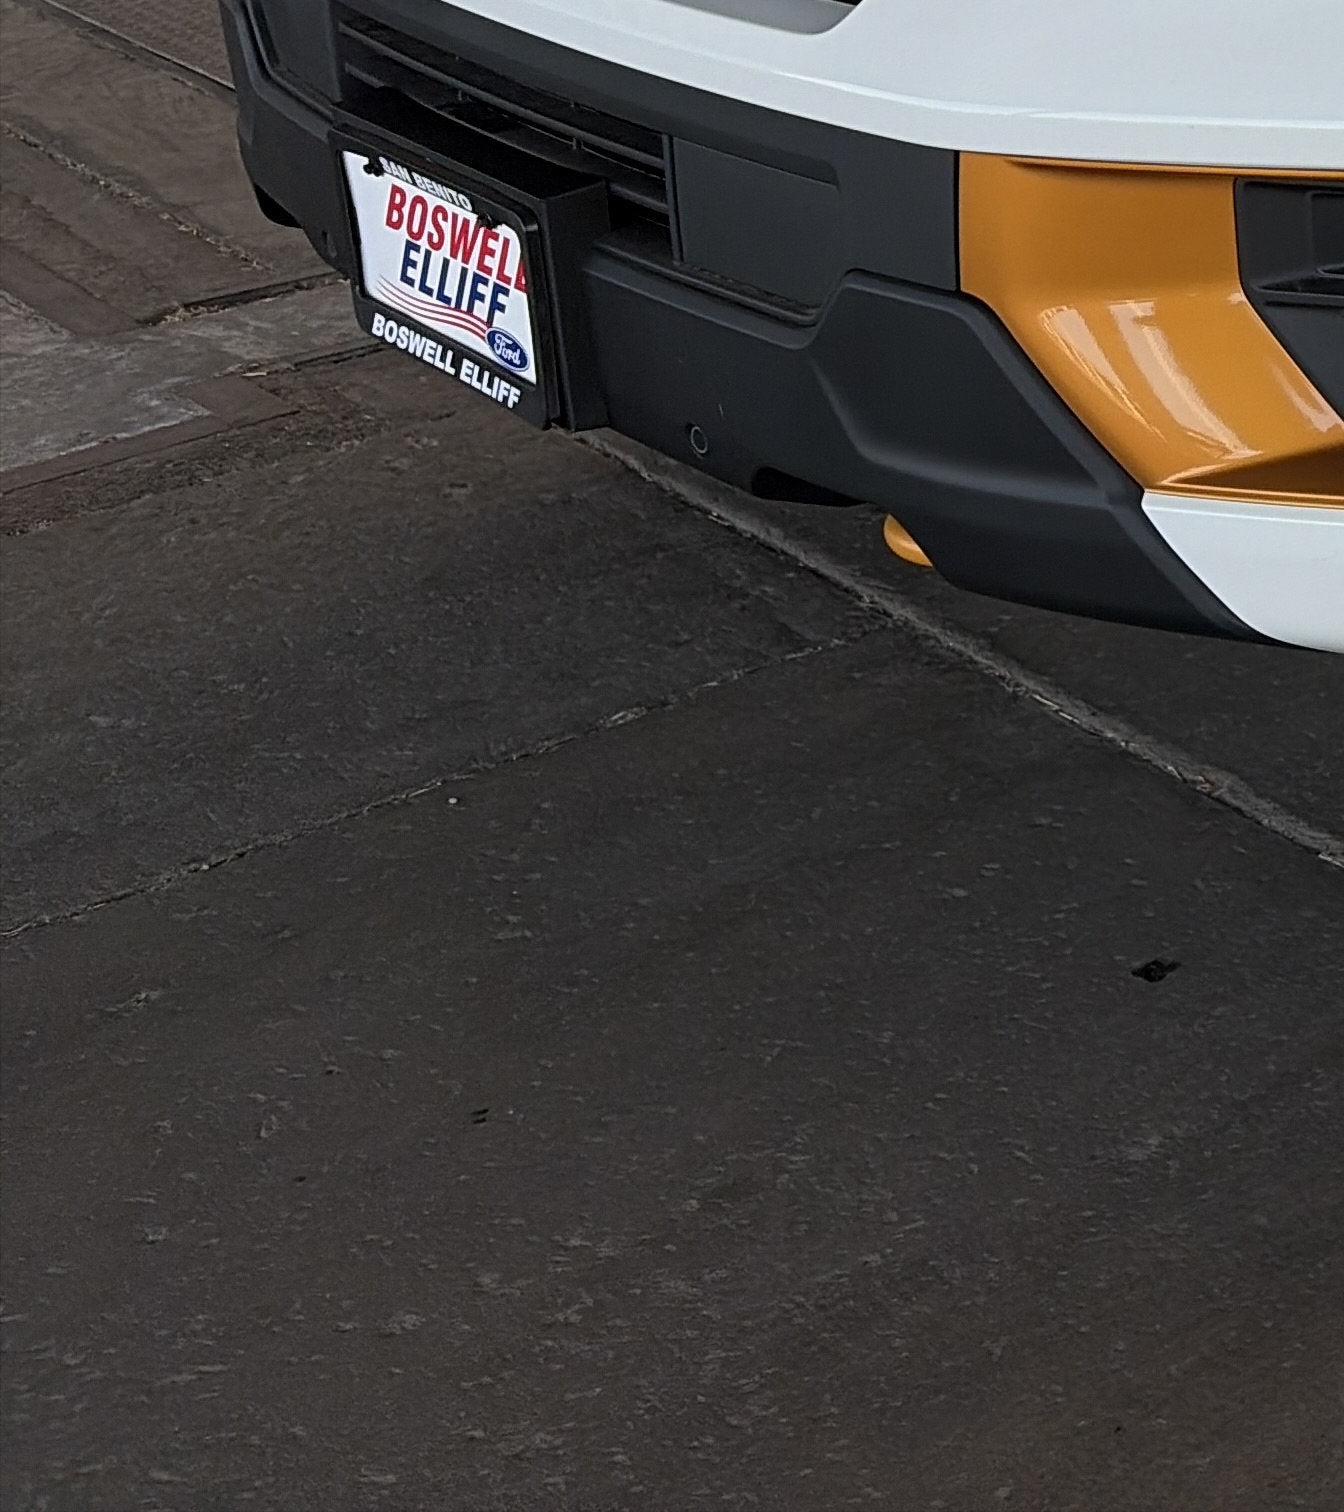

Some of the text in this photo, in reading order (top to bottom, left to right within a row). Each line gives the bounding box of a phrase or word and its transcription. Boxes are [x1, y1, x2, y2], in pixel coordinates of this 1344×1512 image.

[379, 156, 473, 212] SAN BENITO
[400, 239, 510, 326] ELLIFF
[371, 312, 521, 409] BOSWELL ELLIFF
[493, 333, 521, 365] Ford
